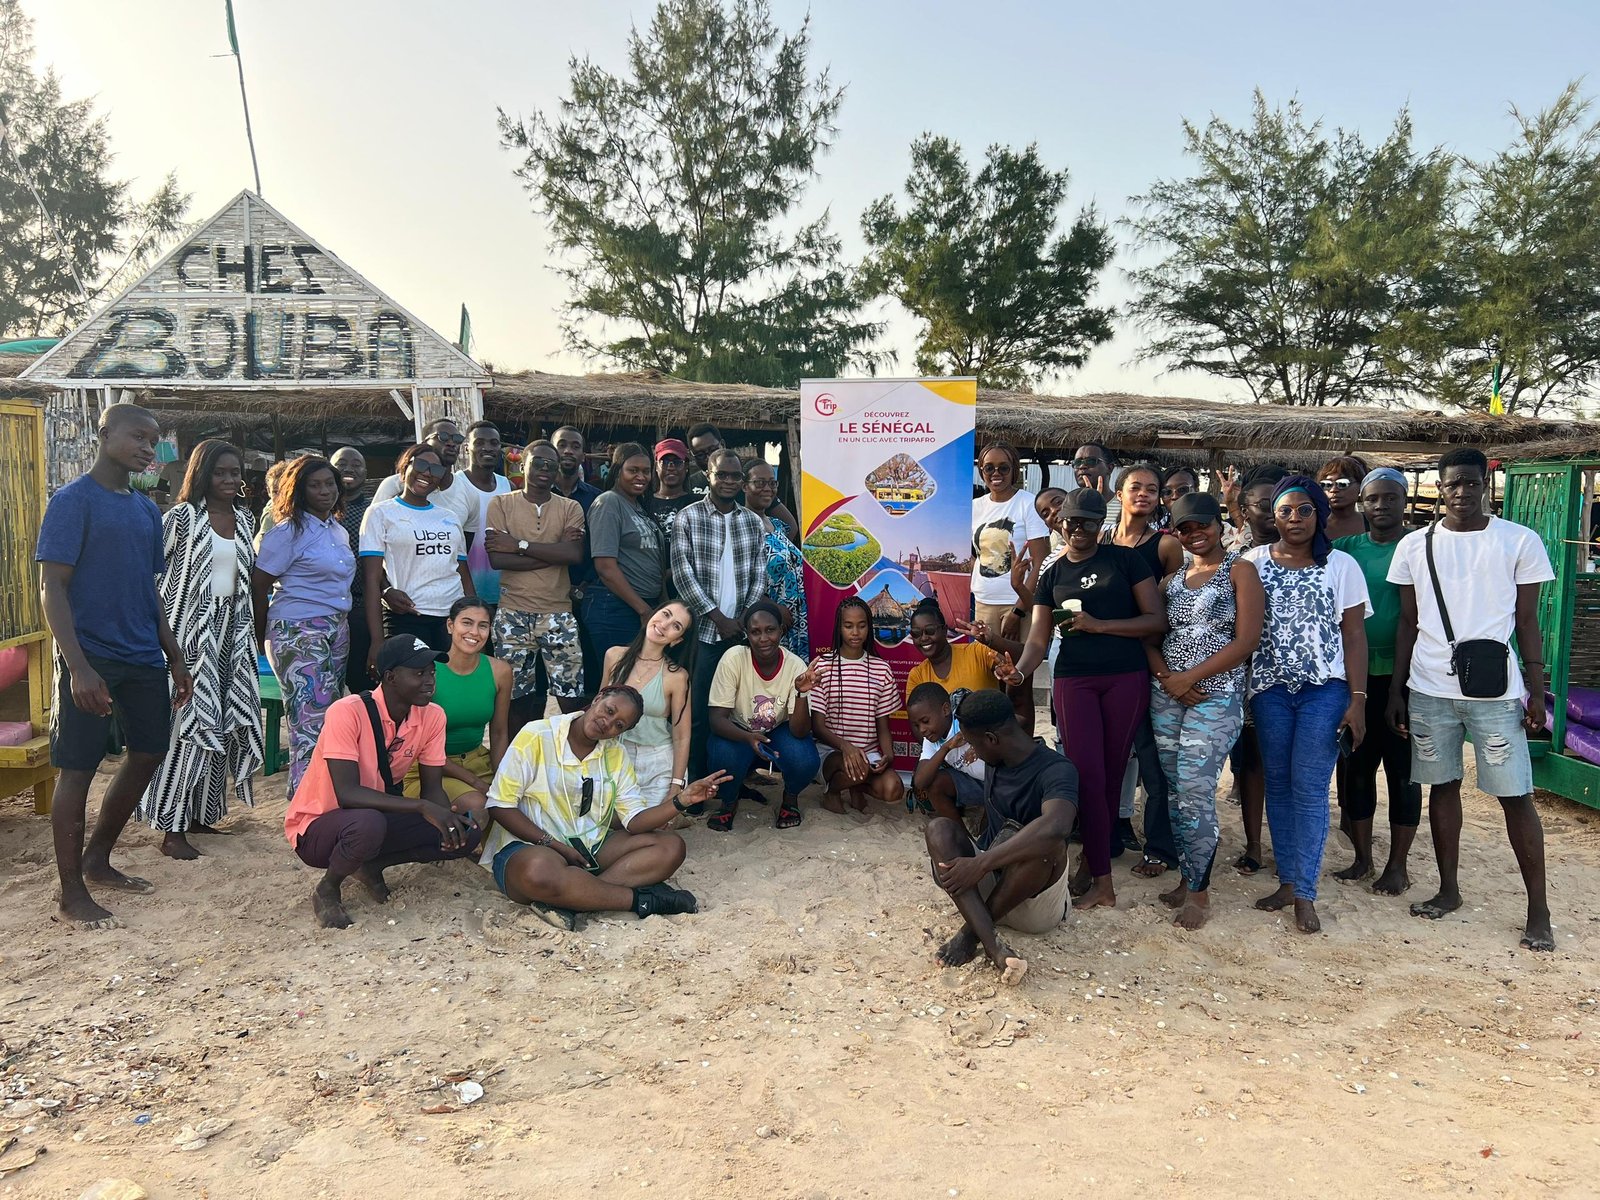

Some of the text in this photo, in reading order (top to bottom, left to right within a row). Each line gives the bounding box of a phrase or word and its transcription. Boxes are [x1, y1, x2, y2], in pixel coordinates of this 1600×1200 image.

[176, 244, 328, 295] CHEZ
[66, 305, 418, 379] BOUBA
[839, 419, 935, 434] LE SÉNÉGAL
[413, 529, 452, 541] Uber
[415, 543, 452, 556] Eats
